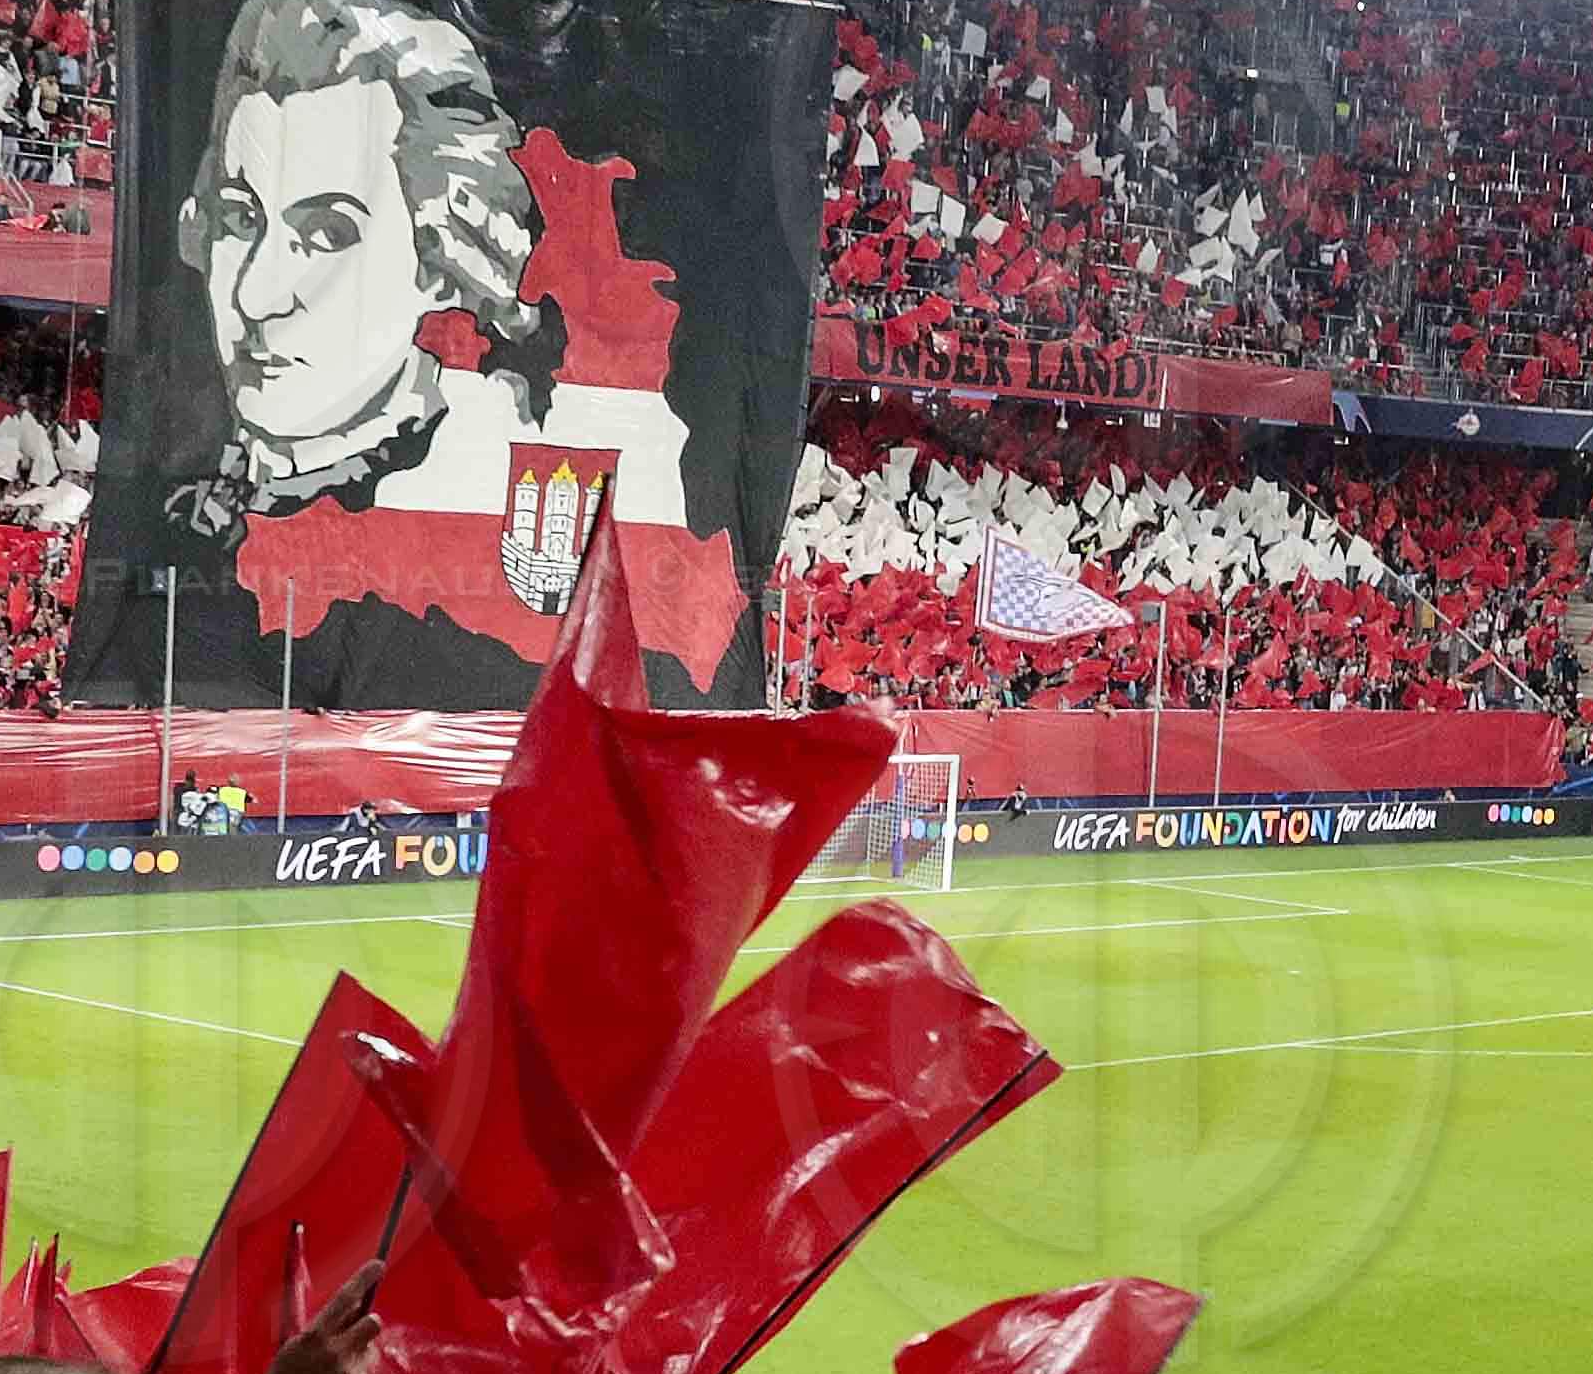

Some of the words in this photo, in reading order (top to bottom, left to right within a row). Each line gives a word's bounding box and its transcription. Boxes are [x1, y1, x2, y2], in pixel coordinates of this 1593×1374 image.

[854, 321, 1012, 389] UNSER
[1028, 341, 1158, 401] LAND!
[1053, 813, 1131, 851] UEFA
[1334, 806, 1365, 841] for
[1367, 803, 1438, 832] children
[275, 835, 388, 884] UEFA
